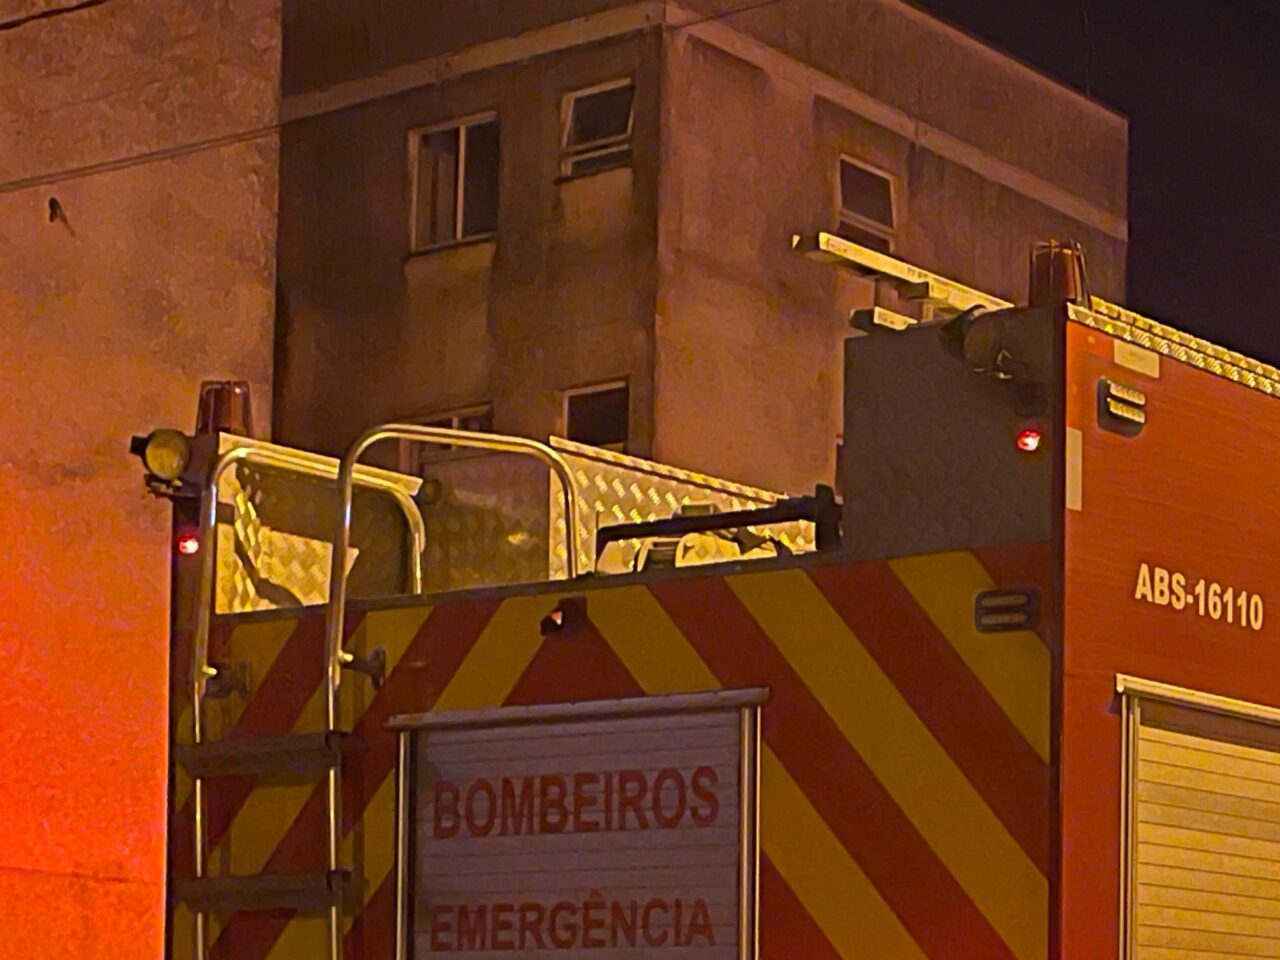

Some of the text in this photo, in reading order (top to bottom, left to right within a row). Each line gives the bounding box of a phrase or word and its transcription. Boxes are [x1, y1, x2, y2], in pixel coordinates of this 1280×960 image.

[1134, 563, 1264, 631] ABS-16110
[433, 766, 720, 839] BOMBEIROS
[429, 889, 717, 952] EMERGÊNCIA
